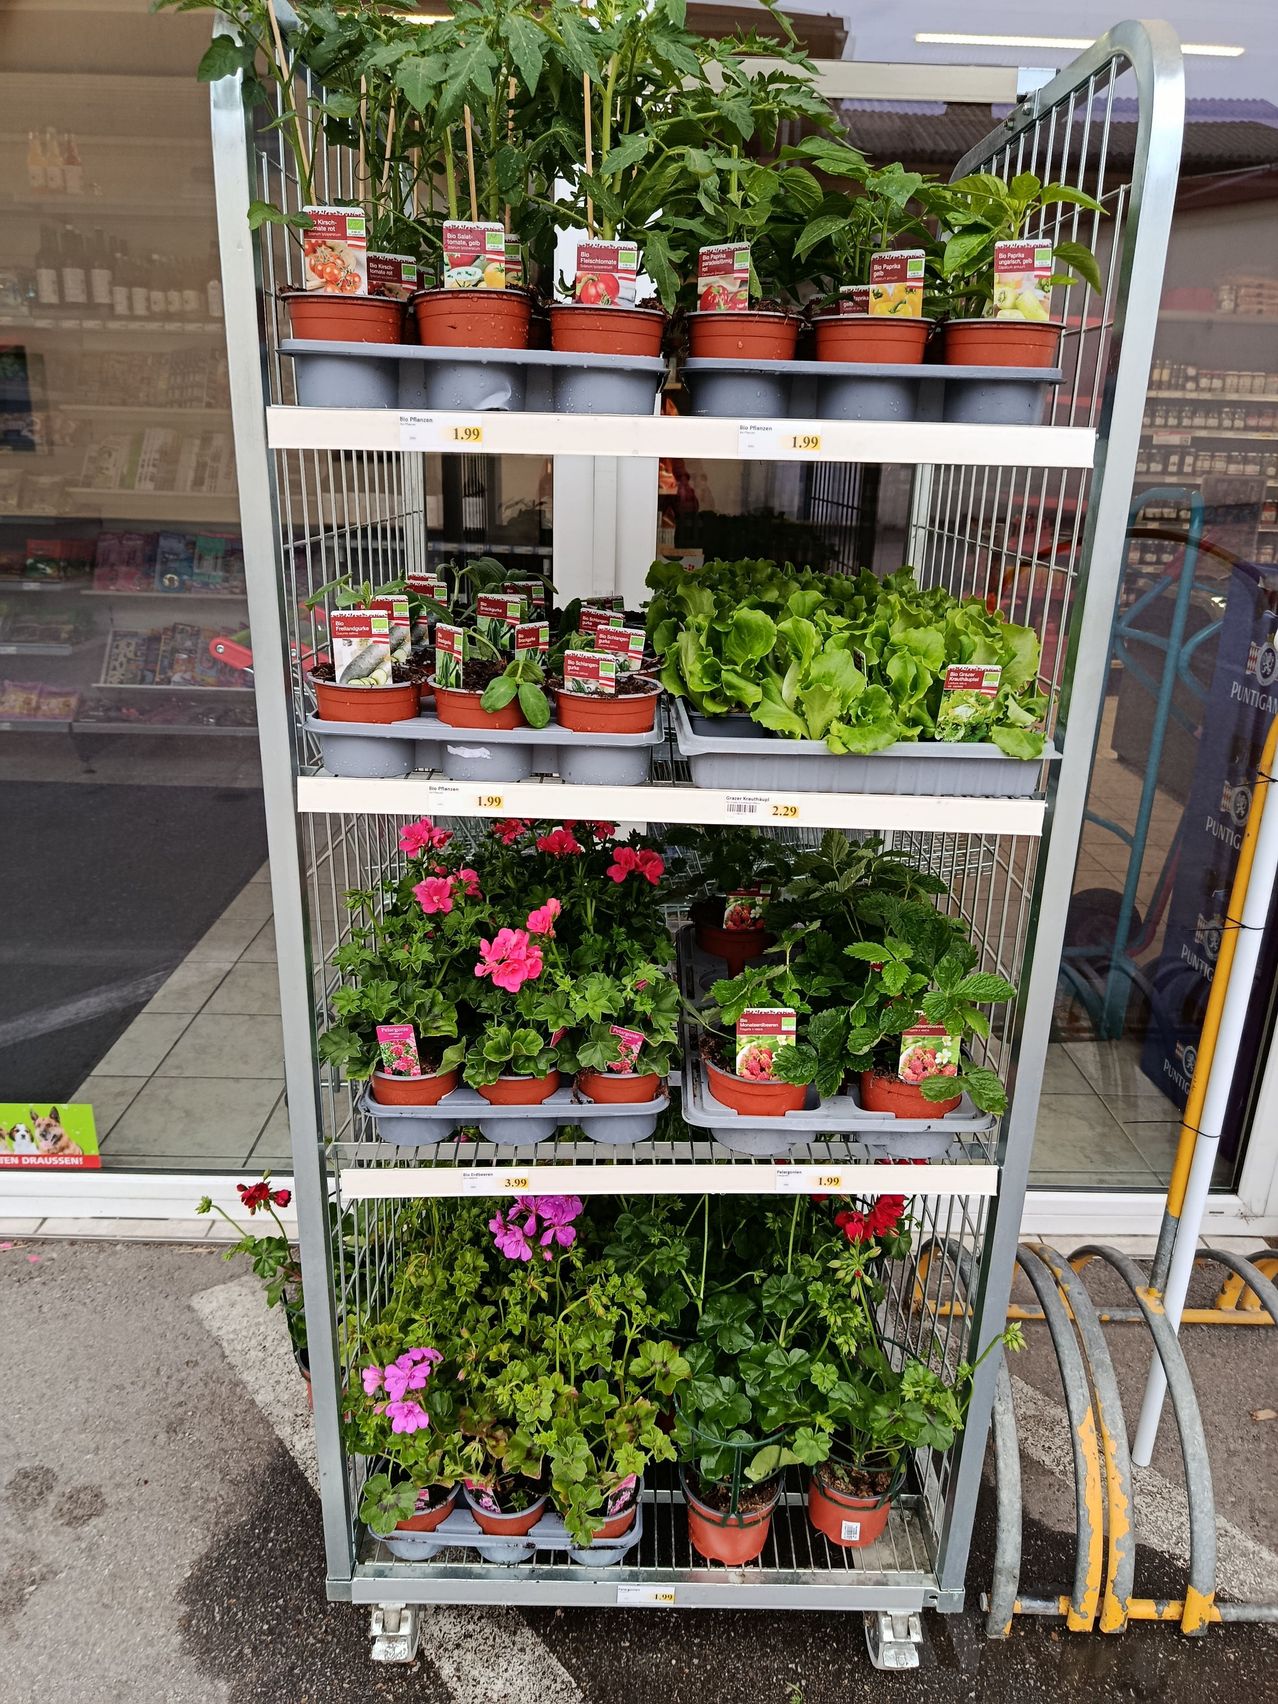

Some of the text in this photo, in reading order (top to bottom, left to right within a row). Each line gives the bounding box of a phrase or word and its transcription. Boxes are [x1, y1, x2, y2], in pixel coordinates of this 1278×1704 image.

[454, 428, 480, 440] 1.99
[792, 436, 818, 448] 1.99
[478, 796, 501, 807] 1.99
[772, 806, 797, 816] 2.29
[22, 1157, 83, 1165] DRAUSSEN!
[505, 1178, 527, 1187] 3.99
[819, 1177, 839, 1186] 1.99
